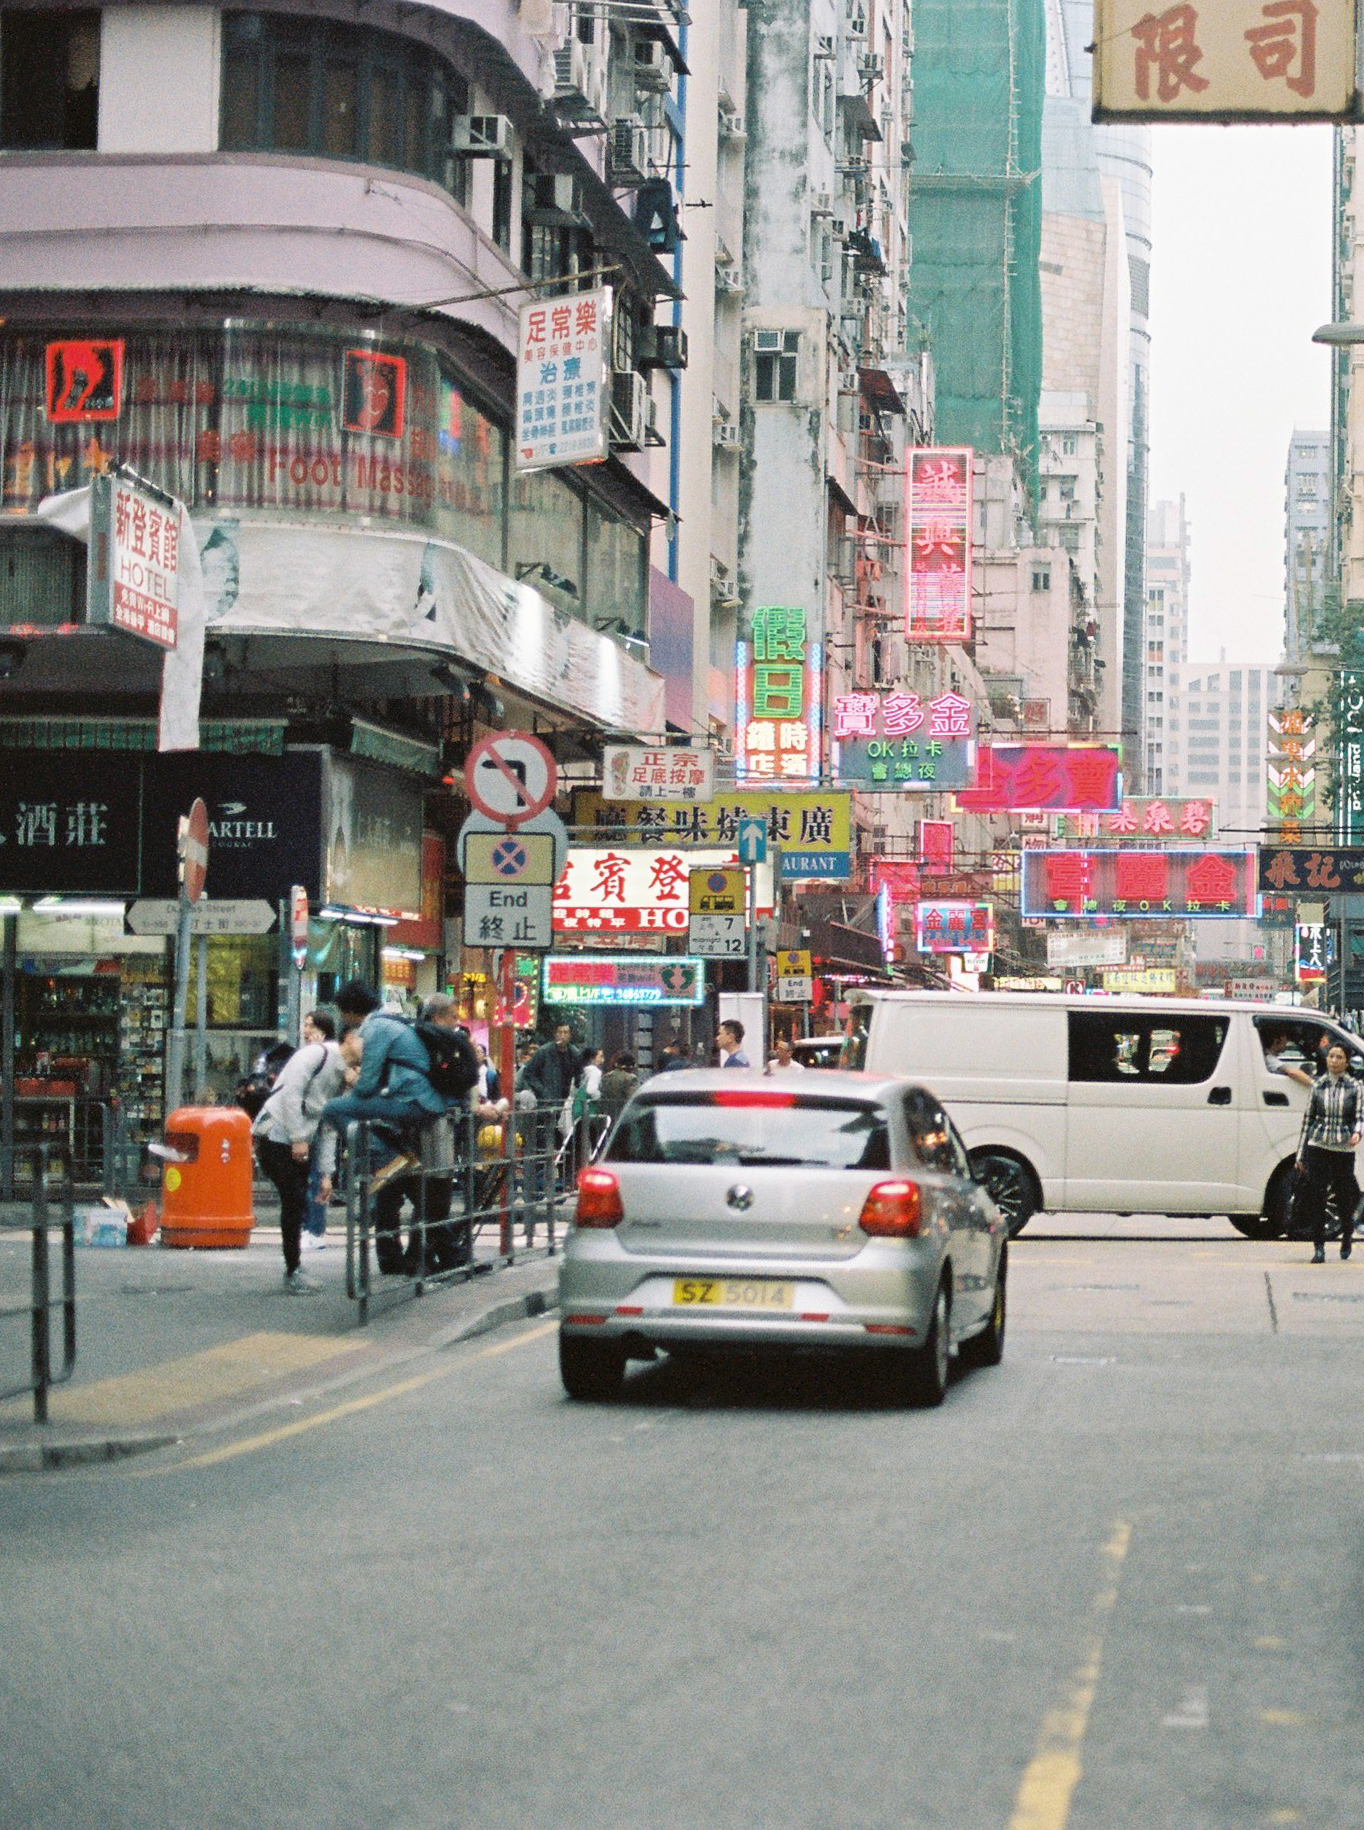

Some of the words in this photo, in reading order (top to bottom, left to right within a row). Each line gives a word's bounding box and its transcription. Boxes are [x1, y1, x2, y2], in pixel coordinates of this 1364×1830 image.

[527, 299, 596, 345] 足常樂
[524, 337, 597, 363] 美容保健中心
[540, 357, 581, 385] 治療
[269, 446, 341, 486] Foot
[116, 488, 179, 574] 新登賓館
[121, 554, 172, 603] HOTEL
[752, 605, 805, 718] 假日
[640, 752, 699, 767] 正宗
[632, 766, 705, 785] 足底按摩
[0, 801, 109, 847] 酒莊
[208, 821, 277, 838] ARTELL
[782, 857, 837, 871] AURANT
[489, 891, 528, 908] End
[480, 915, 538, 941] 終止
[725, 918, 734, 931] 7
[926, 908, 988, 931] 金麗宮
[692, 937, 722, 945] midnight
[725, 939, 742, 951] 12
[787, 979, 803, 988] End
[681, 1283, 713, 1303] SZ
[726, 1286, 784, 1305] 5014
